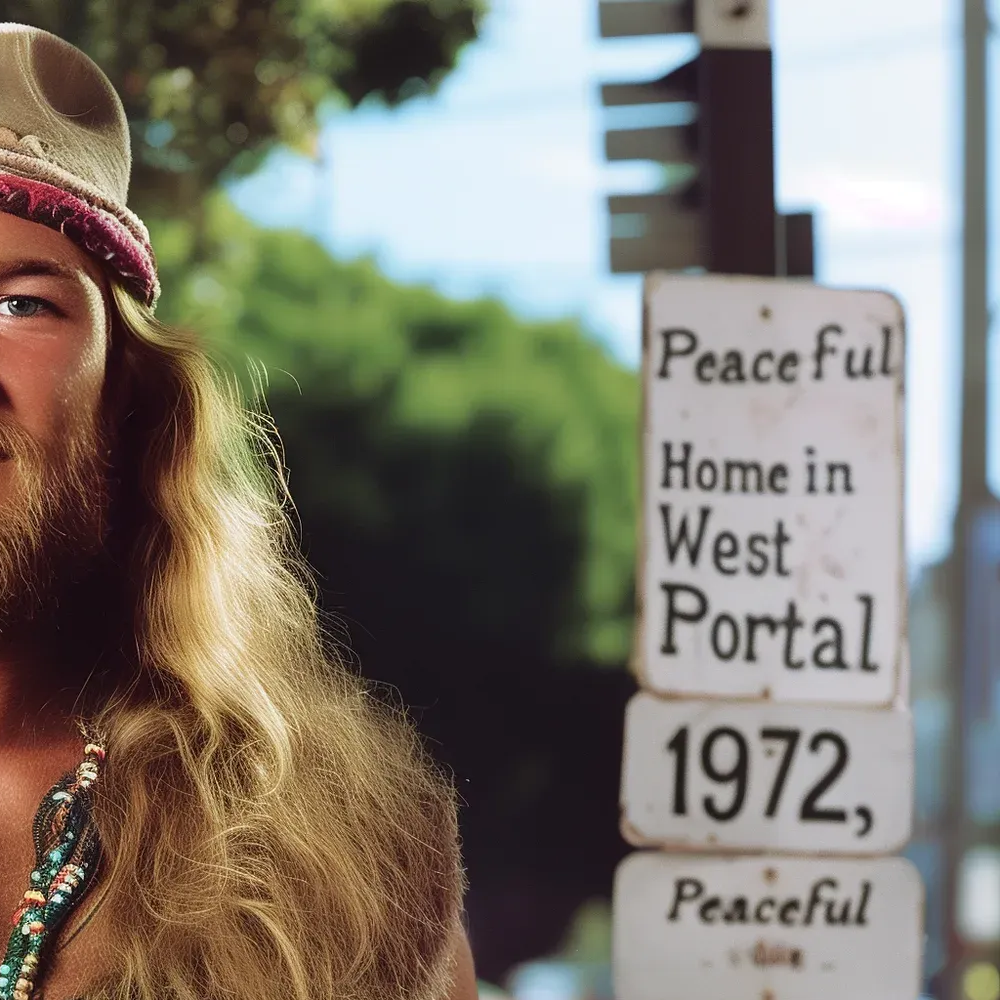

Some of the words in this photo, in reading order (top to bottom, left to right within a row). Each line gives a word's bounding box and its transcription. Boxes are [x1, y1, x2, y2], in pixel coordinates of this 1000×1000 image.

[660, 440, 790, 494] Home
[804, 446, 854, 494] in
[659, 502, 791, 577] West
[659, 581, 879, 673] Portal
[665, 725, 874, 838] 1972,
[666, 875, 873, 928] Peaceful
